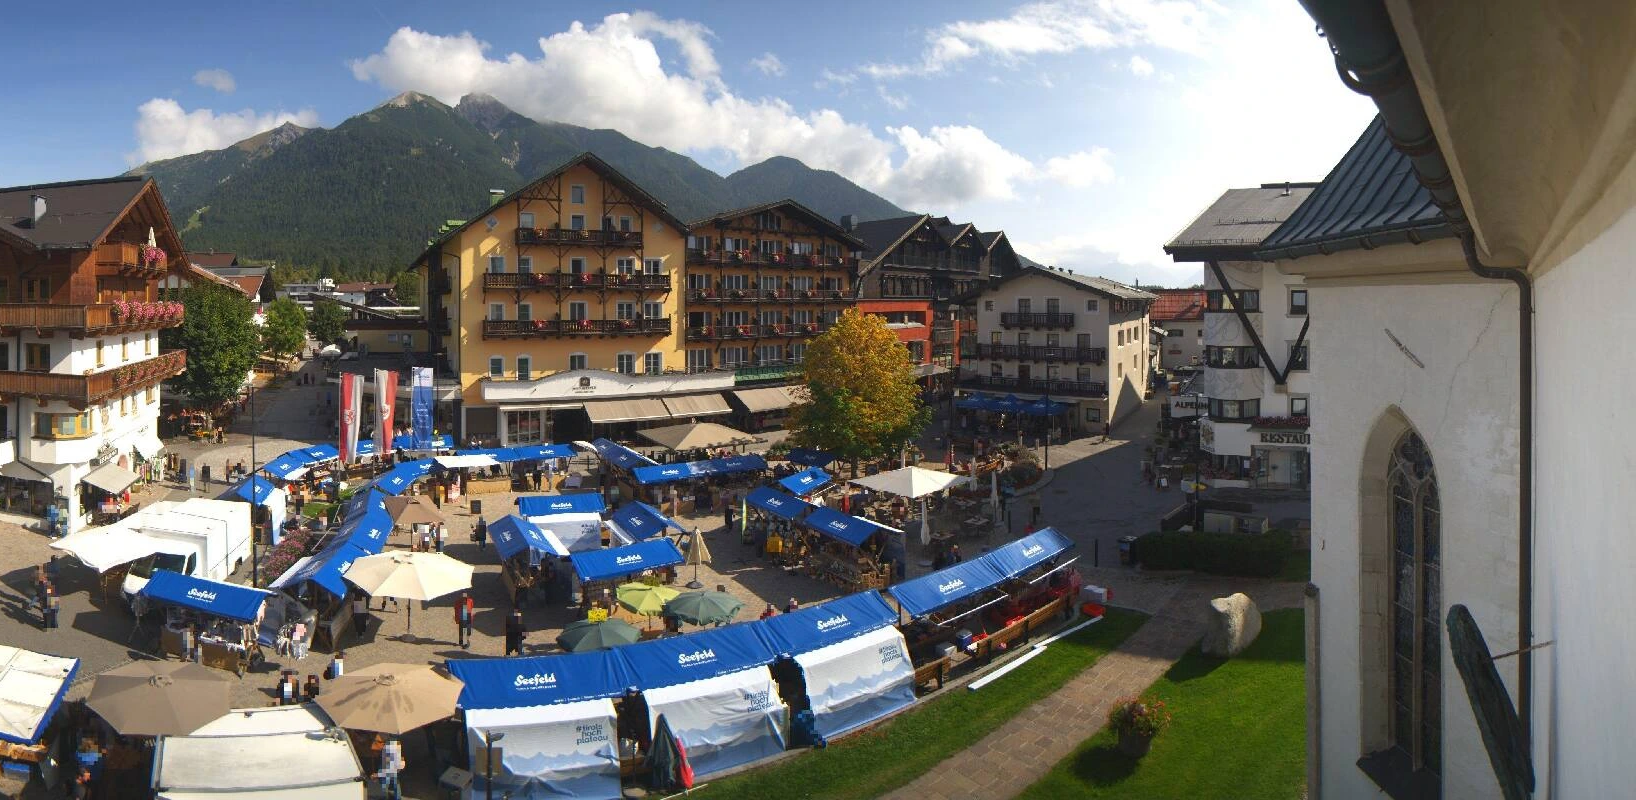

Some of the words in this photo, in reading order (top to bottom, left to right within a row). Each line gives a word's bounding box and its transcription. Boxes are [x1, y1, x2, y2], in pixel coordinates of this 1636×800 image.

[188, 588, 216, 600] Seefeld
[817, 614, 847, 629] Seefeld
[678, 649, 715, 664] Seefeld
[514, 672, 556, 686] Seefeld
[576, 723, 603, 732] #tirols
[576, 735, 608, 745] plateau
[581, 730, 602, 738] hoch
